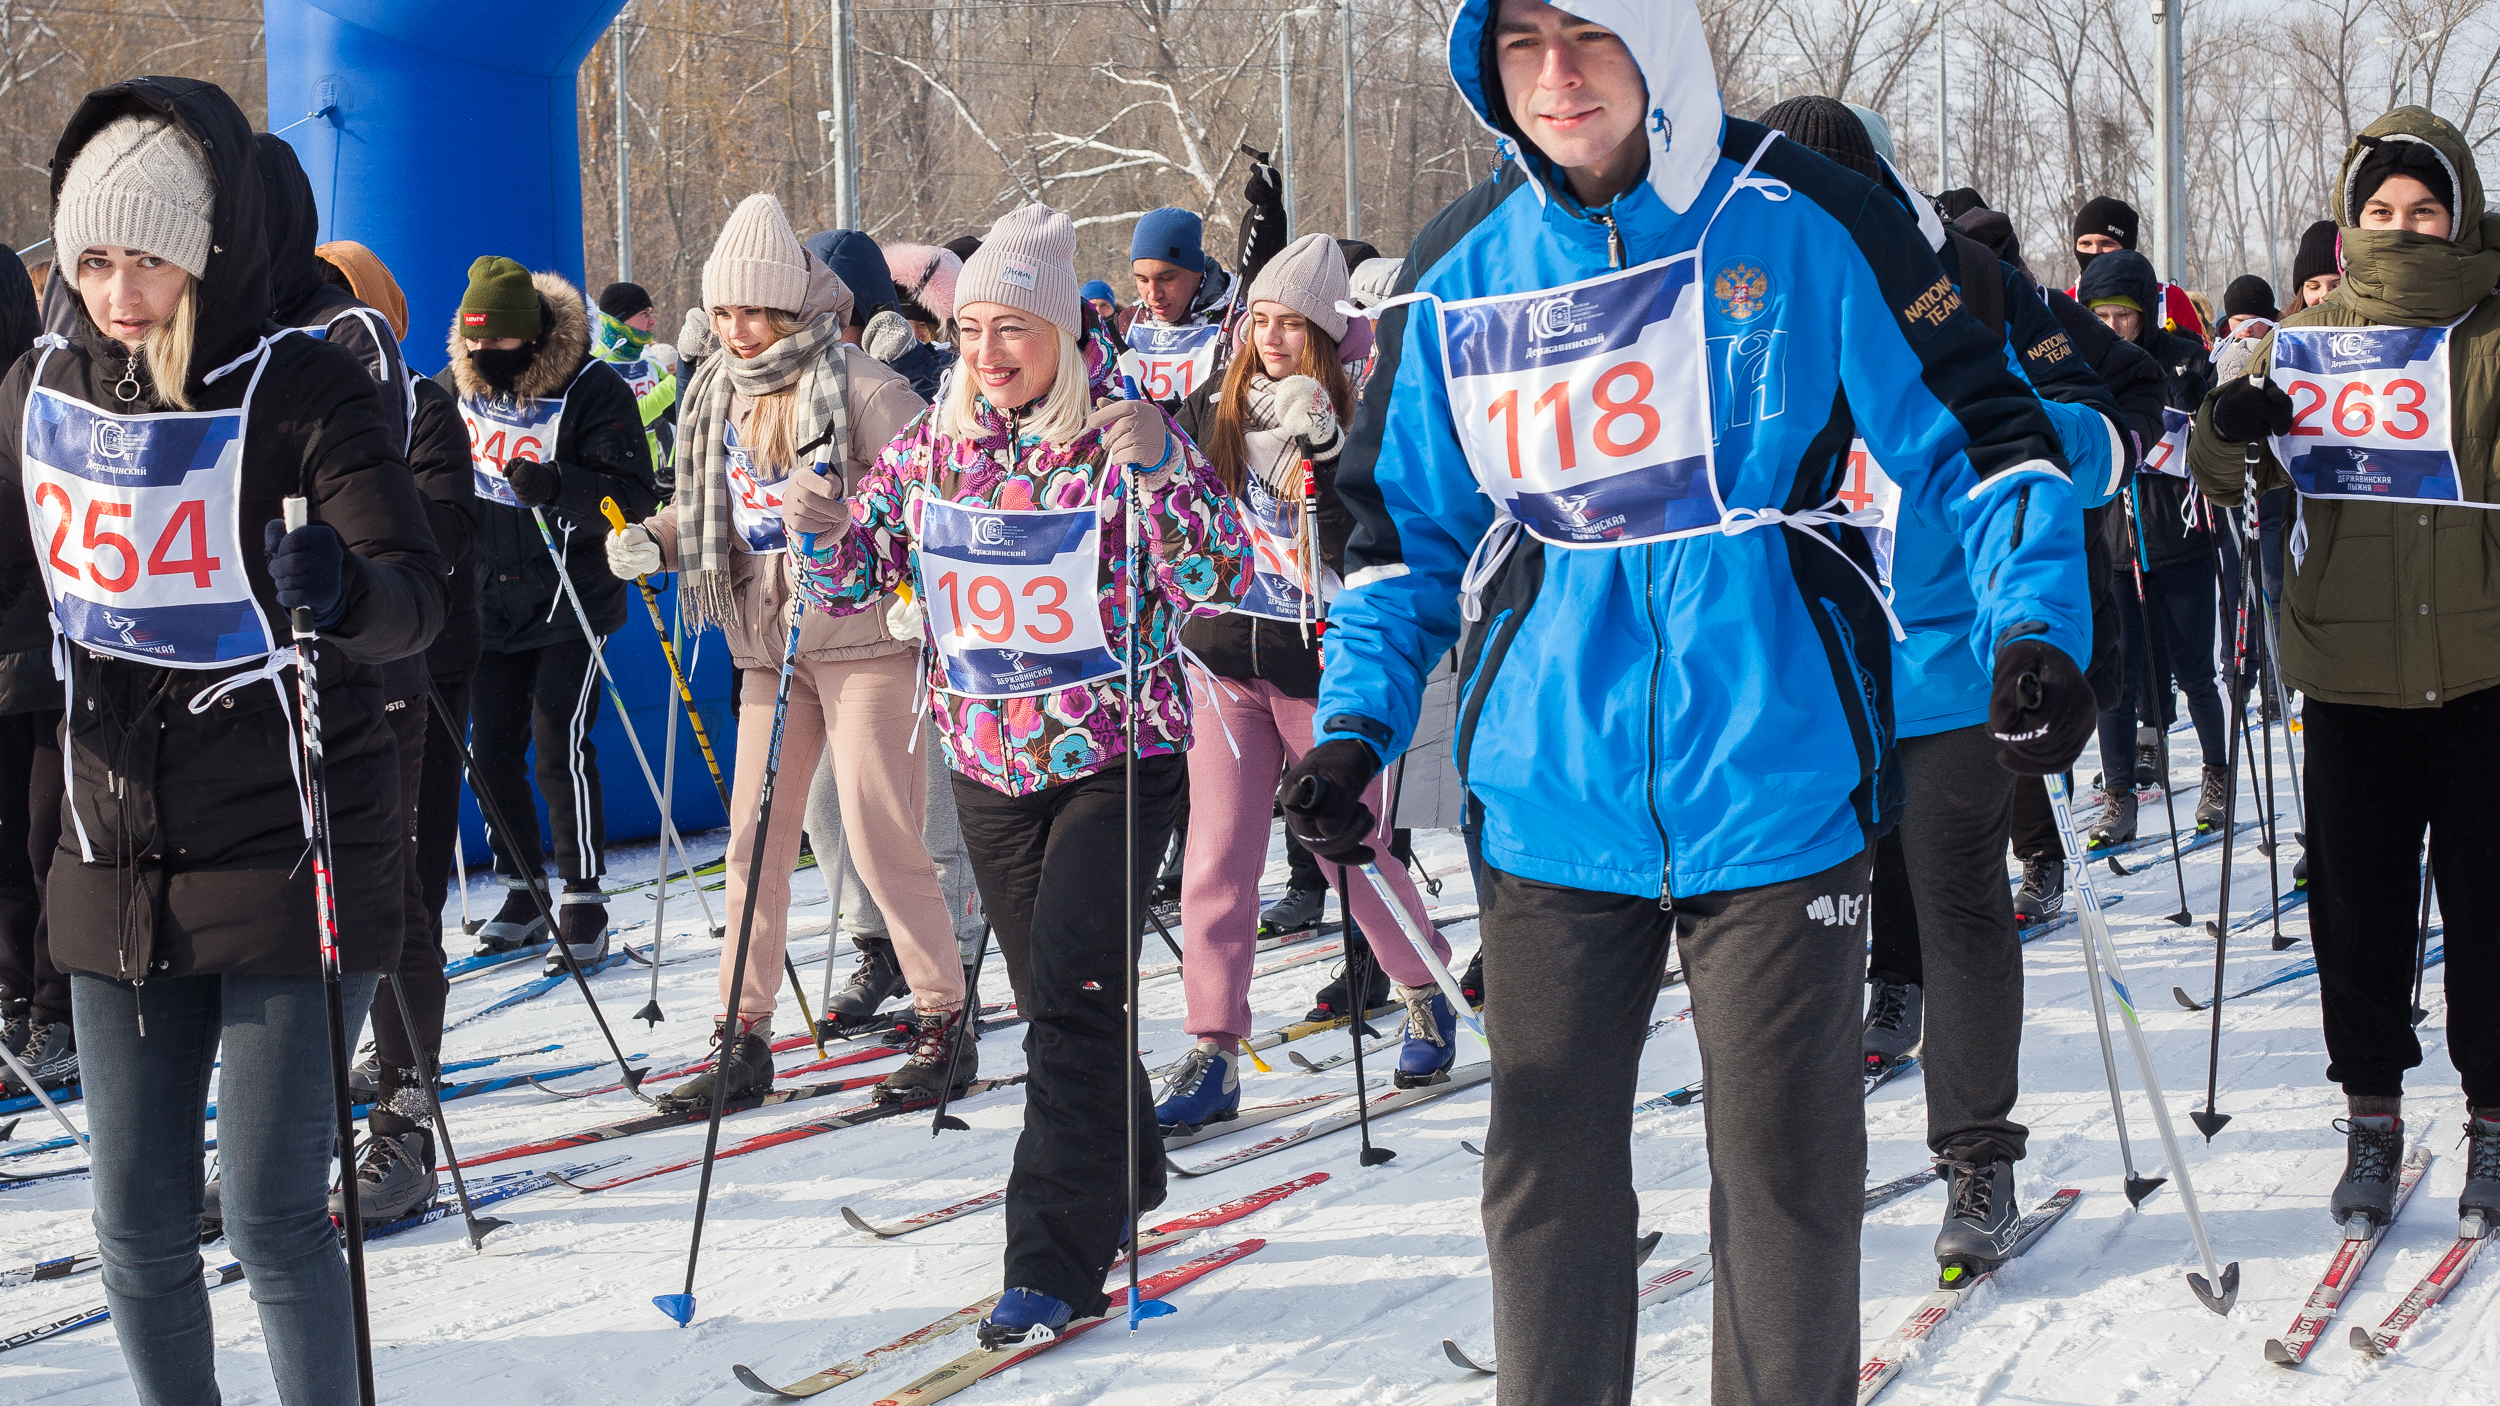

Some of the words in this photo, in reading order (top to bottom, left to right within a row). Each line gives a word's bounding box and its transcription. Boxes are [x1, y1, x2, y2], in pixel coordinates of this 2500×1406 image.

[2107, 224, 2125, 238] SPORT
[1903, 273, 1953, 324] NATIONA
[1924, 290, 1963, 327] TEAM
[1524, 333, 1606, 360] Державинский
[1487, 361, 1662, 480] 118
[2287, 378, 2430, 440] 263
[85, 459, 147, 476] Державинский
[2337, 474, 2392, 484] ДЕРЖАВИНСКАЯ
[2346, 483, 2373, 492] ЛЫЖНЯ
[35, 481, 221, 593] 254
[967, 546, 1027, 557] Державинский
[793, 556, 811, 629] SABLE
[937, 570, 1075, 645] 193
[996, 666, 1053, 686] ДЕРЖАВИНСКАЯ
[1009, 680, 1036, 691] ЛЫЖНЯ
[1035, 676, 1053, 687] 2023
[771, 703, 788, 773] CROSS
[312, 779, 322, 820] TECHNOLOGY
[2053, 803, 2097, 913] SPINE
[1333, 1011, 1370, 1027] SAE
[366, 1214, 424, 1240] CLASSIC
[421, 1207, 446, 1225] 190
